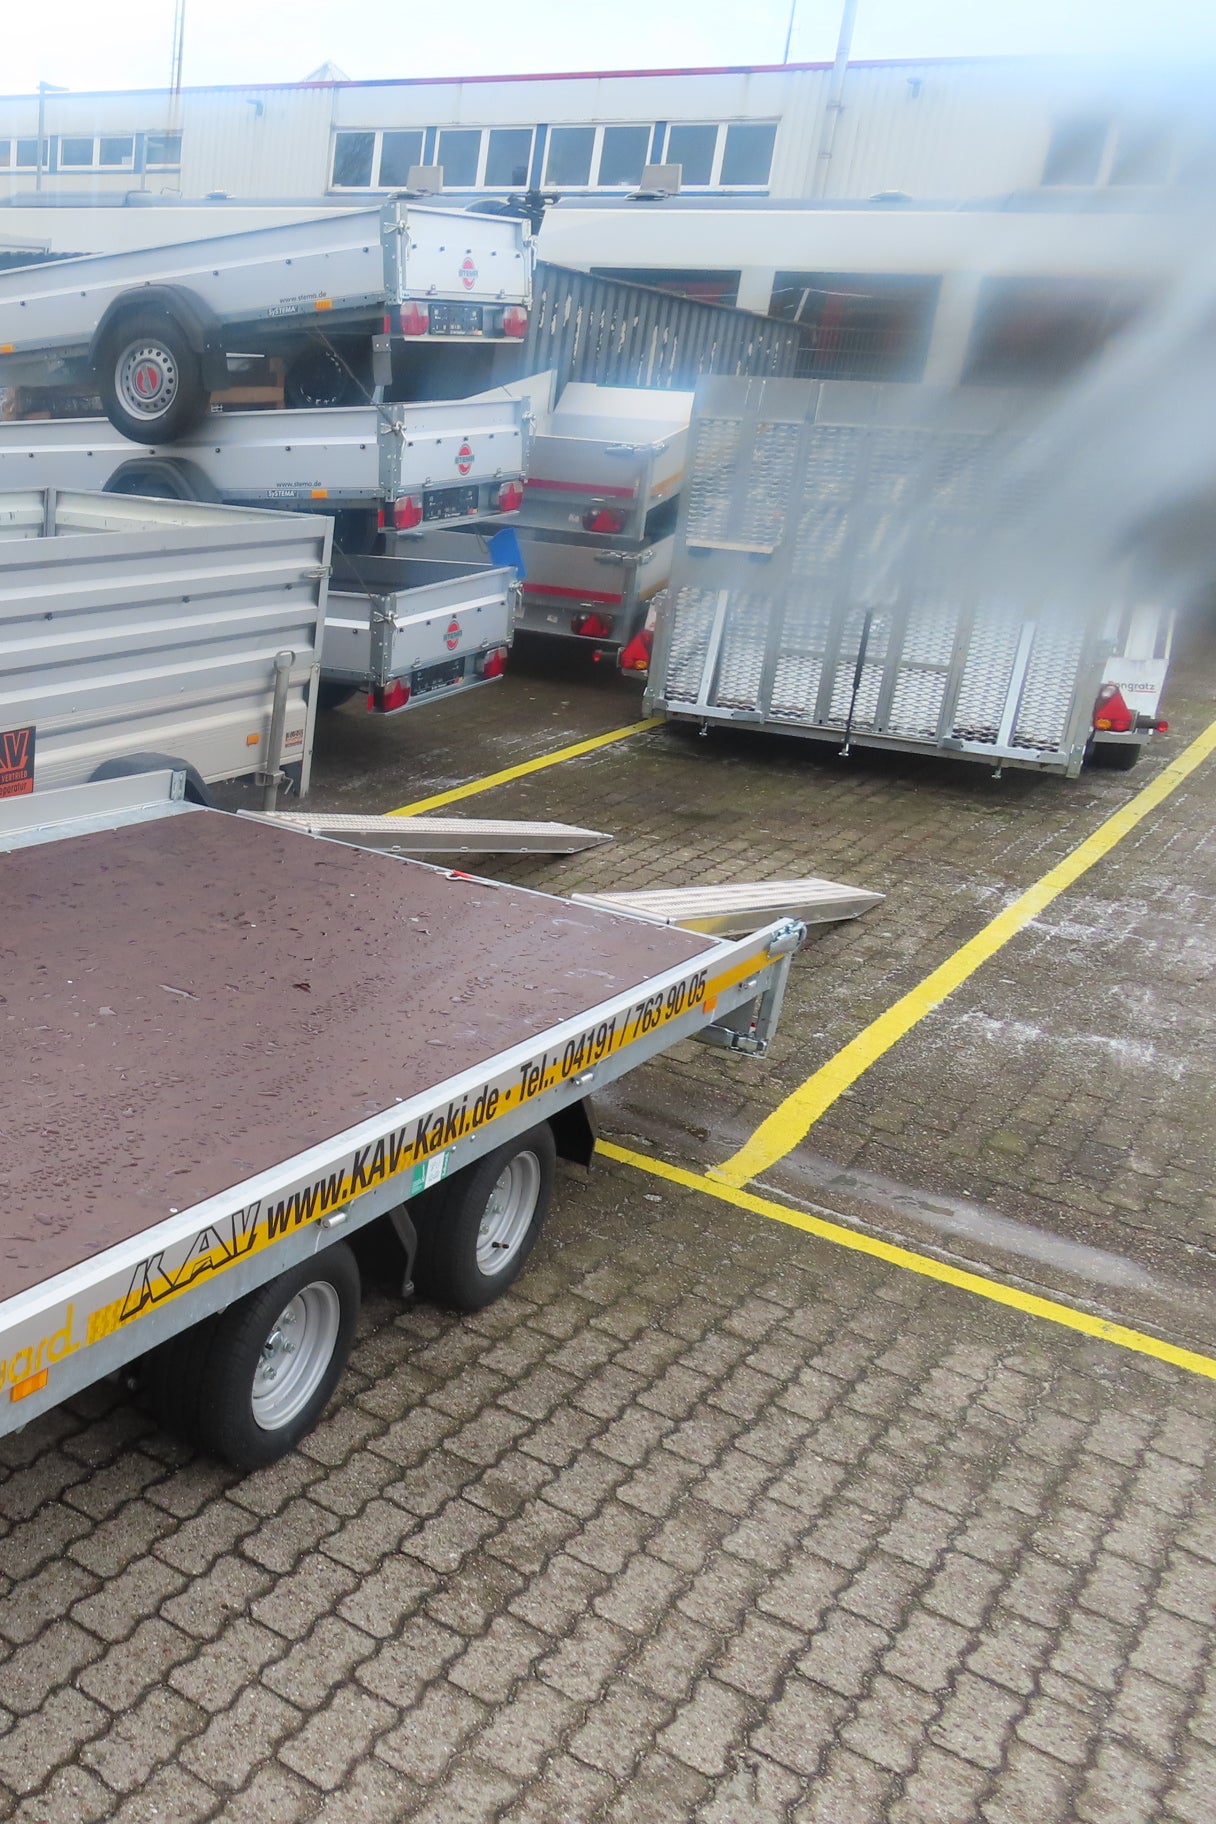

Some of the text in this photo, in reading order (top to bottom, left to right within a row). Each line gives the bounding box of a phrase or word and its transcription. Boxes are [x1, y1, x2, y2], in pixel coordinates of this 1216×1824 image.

[1, 770, 28, 784] VERTRIEB
[120, 1202, 263, 1322] KAV
[266, 1085, 500, 1240] www.KAV-Kaki.de
[519, 1053, 558, 1102] Tel.:
[561, 1016, 617, 1078] 04191
[632, 992, 664, 1039] 763
[664, 980, 687, 1021] 90
[687, 969, 709, 1008] 05
